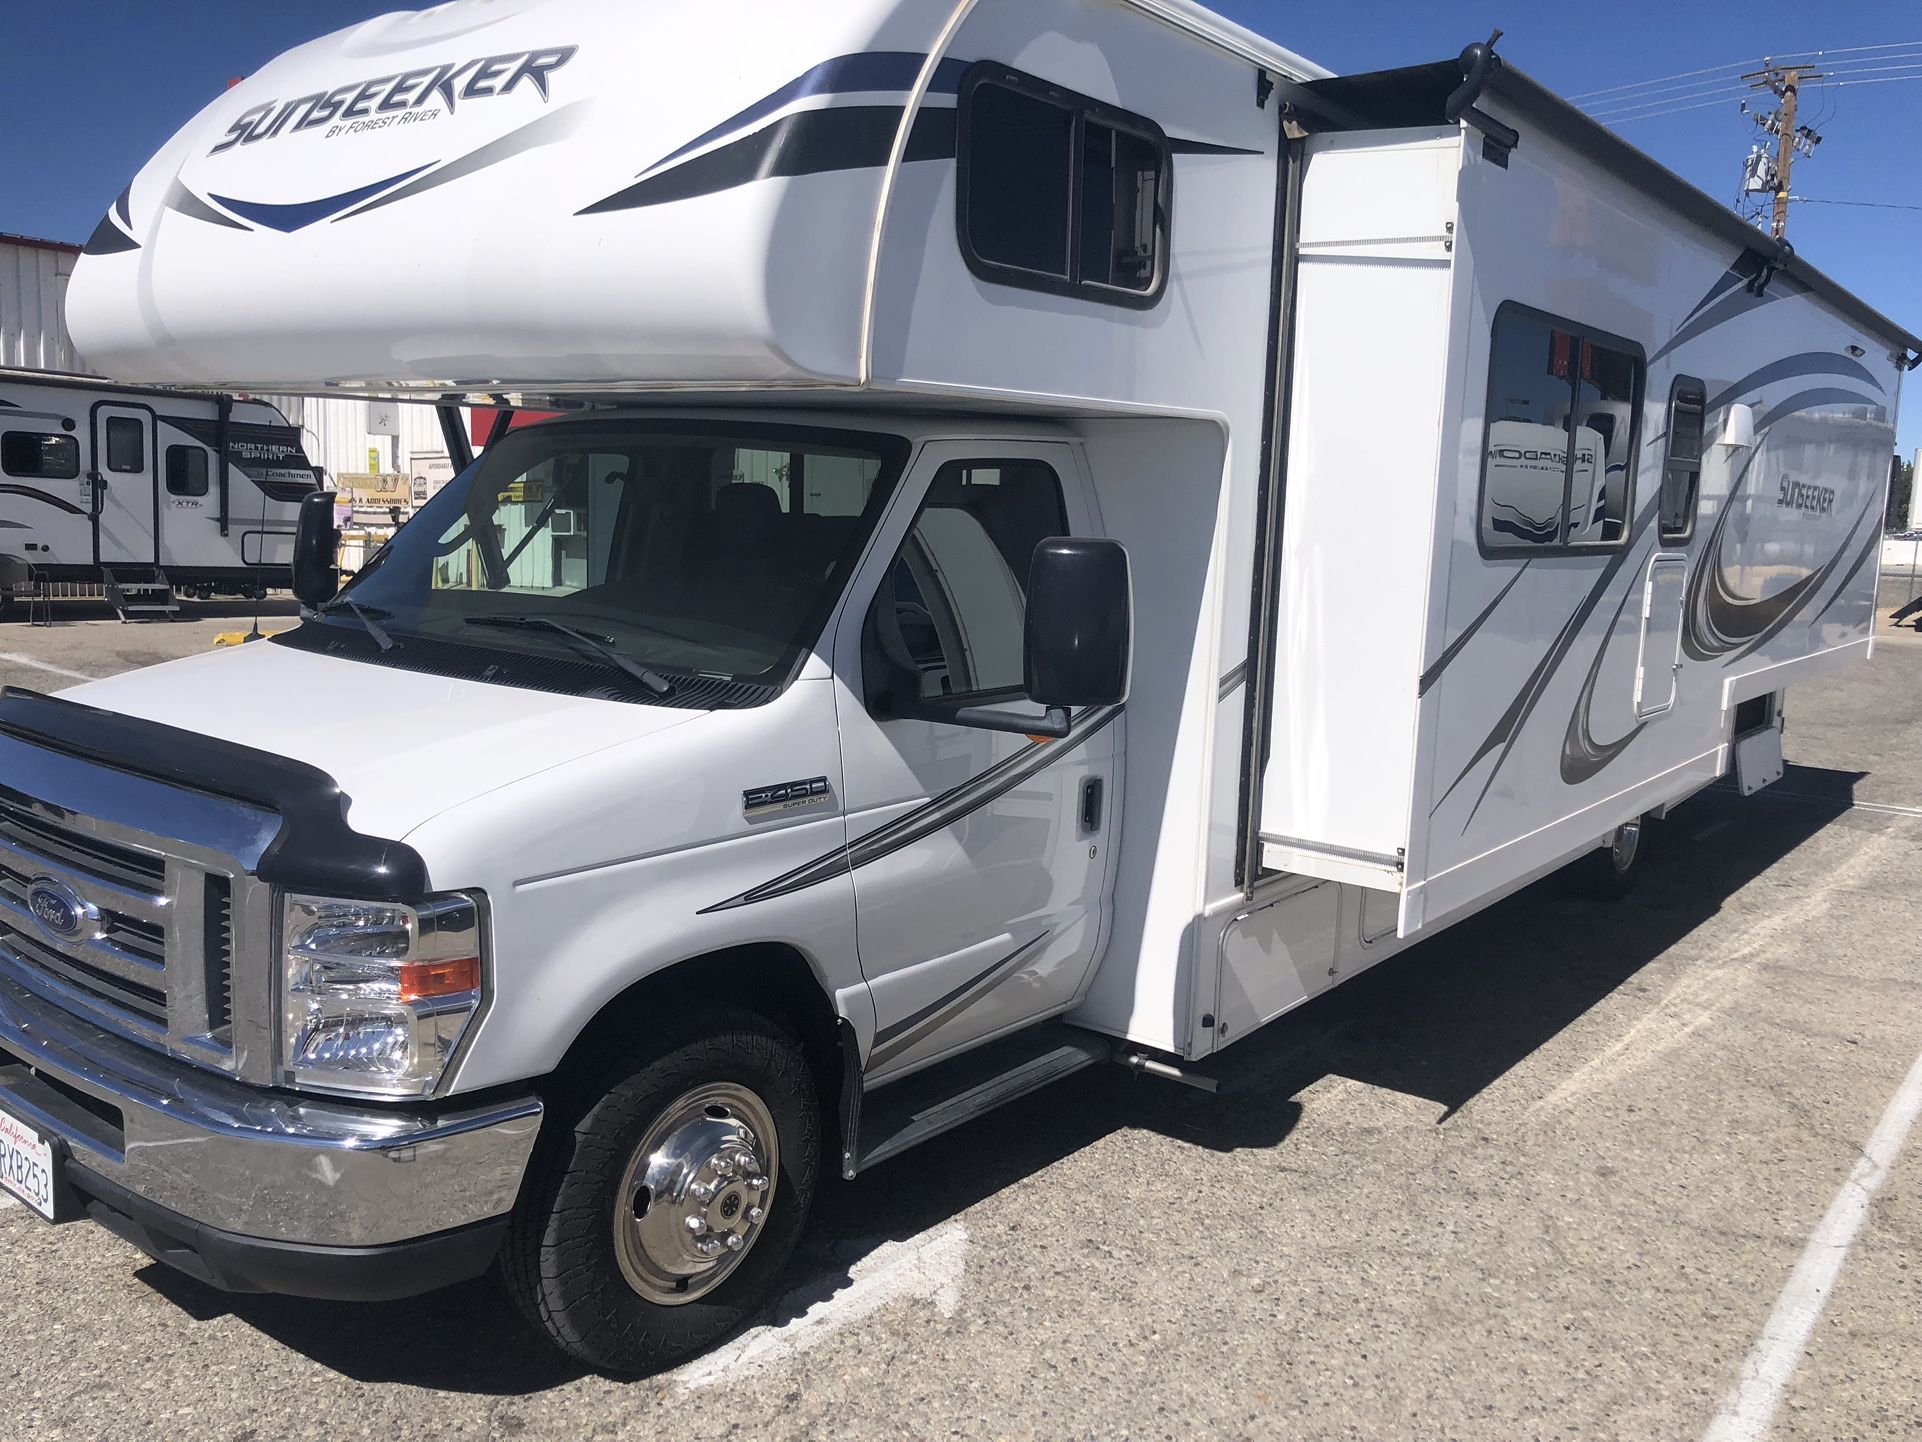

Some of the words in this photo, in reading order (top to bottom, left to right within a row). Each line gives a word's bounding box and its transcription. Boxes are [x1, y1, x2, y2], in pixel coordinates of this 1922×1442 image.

[206, 44, 580, 158] SUNSEEKER
[325, 125, 346, 139] BY
[345, 115, 399, 135] FOREST
[397, 108, 441, 126] RIVER
[229, 441, 296, 454] NORTHERN
[242, 451, 286, 461] SPIRIT
[267, 470, 312, 480] Coachmen
[374, 474, 400, 493] RV
[1776, 473, 1835, 517] SUNSEEKER
[176, 499, 200, 508] XTR
[782, 800, 808, 809] SUPER
[808, 795, 828, 805] DUTY
[35, 893, 66, 925] Ford
